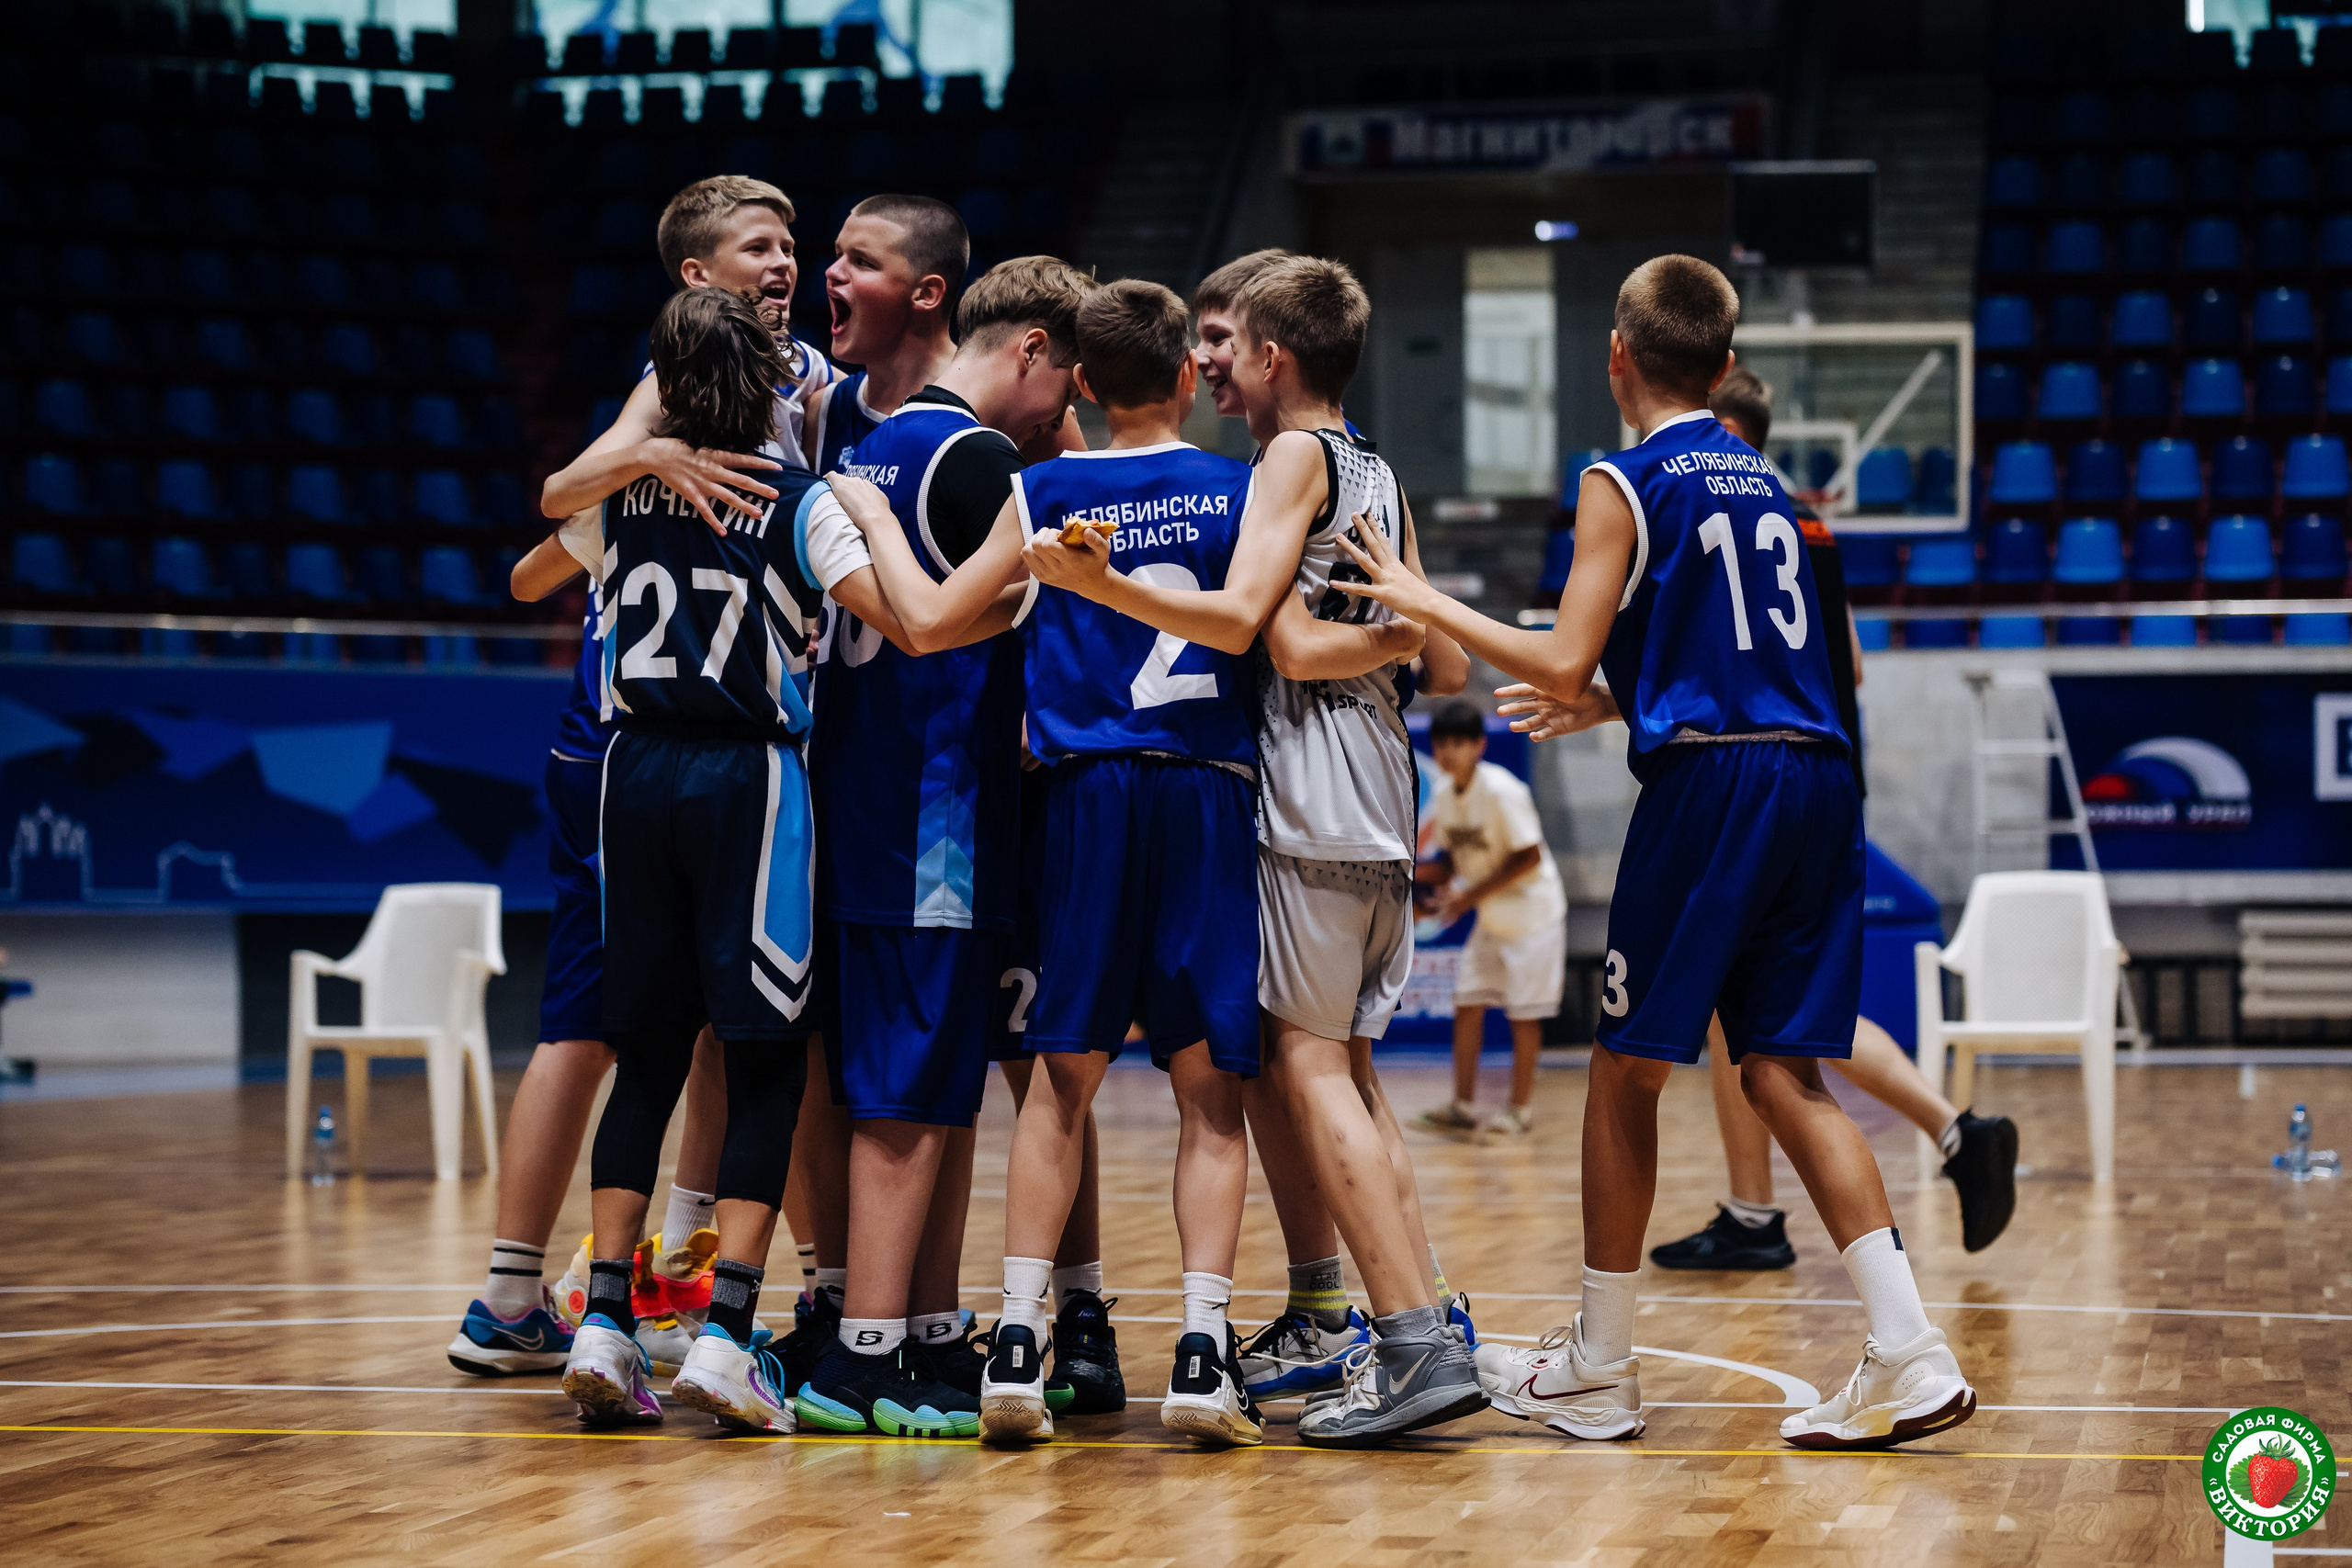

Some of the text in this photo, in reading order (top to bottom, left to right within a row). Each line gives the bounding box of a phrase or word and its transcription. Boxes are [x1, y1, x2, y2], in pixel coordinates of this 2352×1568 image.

[1705, 475, 1773, 497] ОБЛАСТЬ
[1108, 521, 1200, 553] БЛАСТЬ
[1697, 512, 1808, 650] 13
[620, 561, 749, 683] 27
[1114, 562, 1219, 710] 2
[1000, 966, 1043, 1033] 2
[1309, 1280, 1340, 1291] COOL
